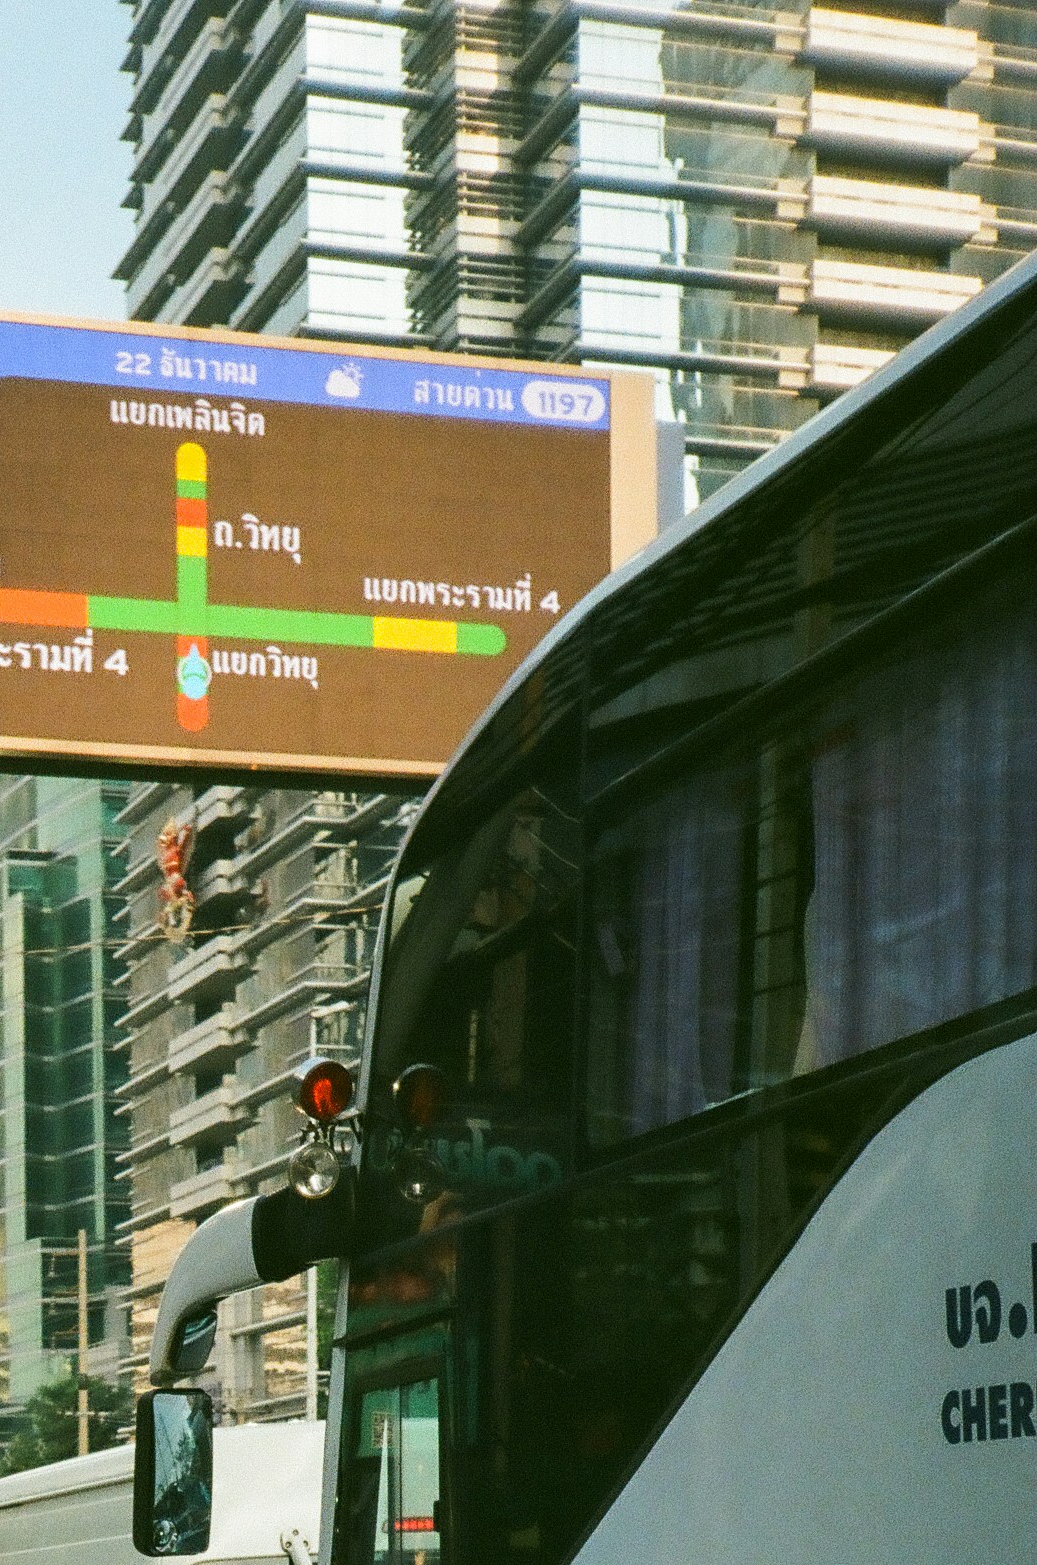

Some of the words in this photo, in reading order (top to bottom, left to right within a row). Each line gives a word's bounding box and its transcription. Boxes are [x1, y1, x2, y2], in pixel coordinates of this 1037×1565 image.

[115, 351, 152, 377] 22
[159, 346, 258, 385] ธันวาคม
[110, 398, 267, 437] แยกเพลินจิต
[538, 388, 594, 418] 1197
[213, 512, 302, 565] ถ.วิทยุ
[363, 573, 532, 613] แยกพระรามที่
[539, 590, 562, 613] 4
[103, 649, 130, 676] 4
[212, 645, 320, 689] แยกวิทยุ
